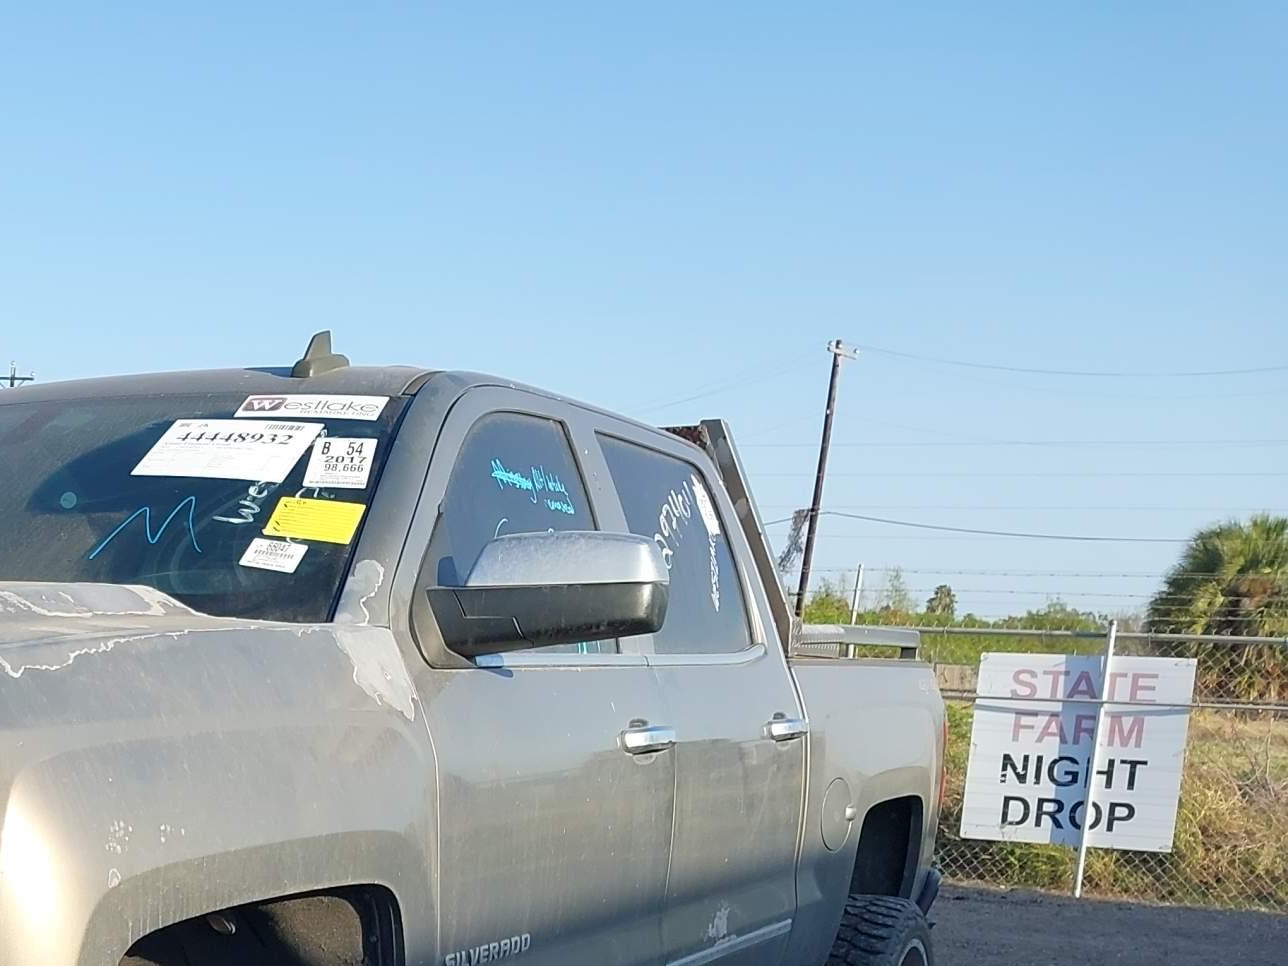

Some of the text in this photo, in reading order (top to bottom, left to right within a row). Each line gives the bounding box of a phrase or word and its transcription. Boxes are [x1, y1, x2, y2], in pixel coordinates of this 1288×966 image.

[246, 400, 379, 413] Westlake
[176, 431, 294, 446] 44448932
[321, 442, 364, 456] B 54
[324, 456, 367, 464] 2017
[1010, 669, 1160, 703] STATE
[1011, 711, 1145, 749] FARM
[1000, 753, 1149, 791] NIGHT
[1000, 795, 1137, 833] DROP
